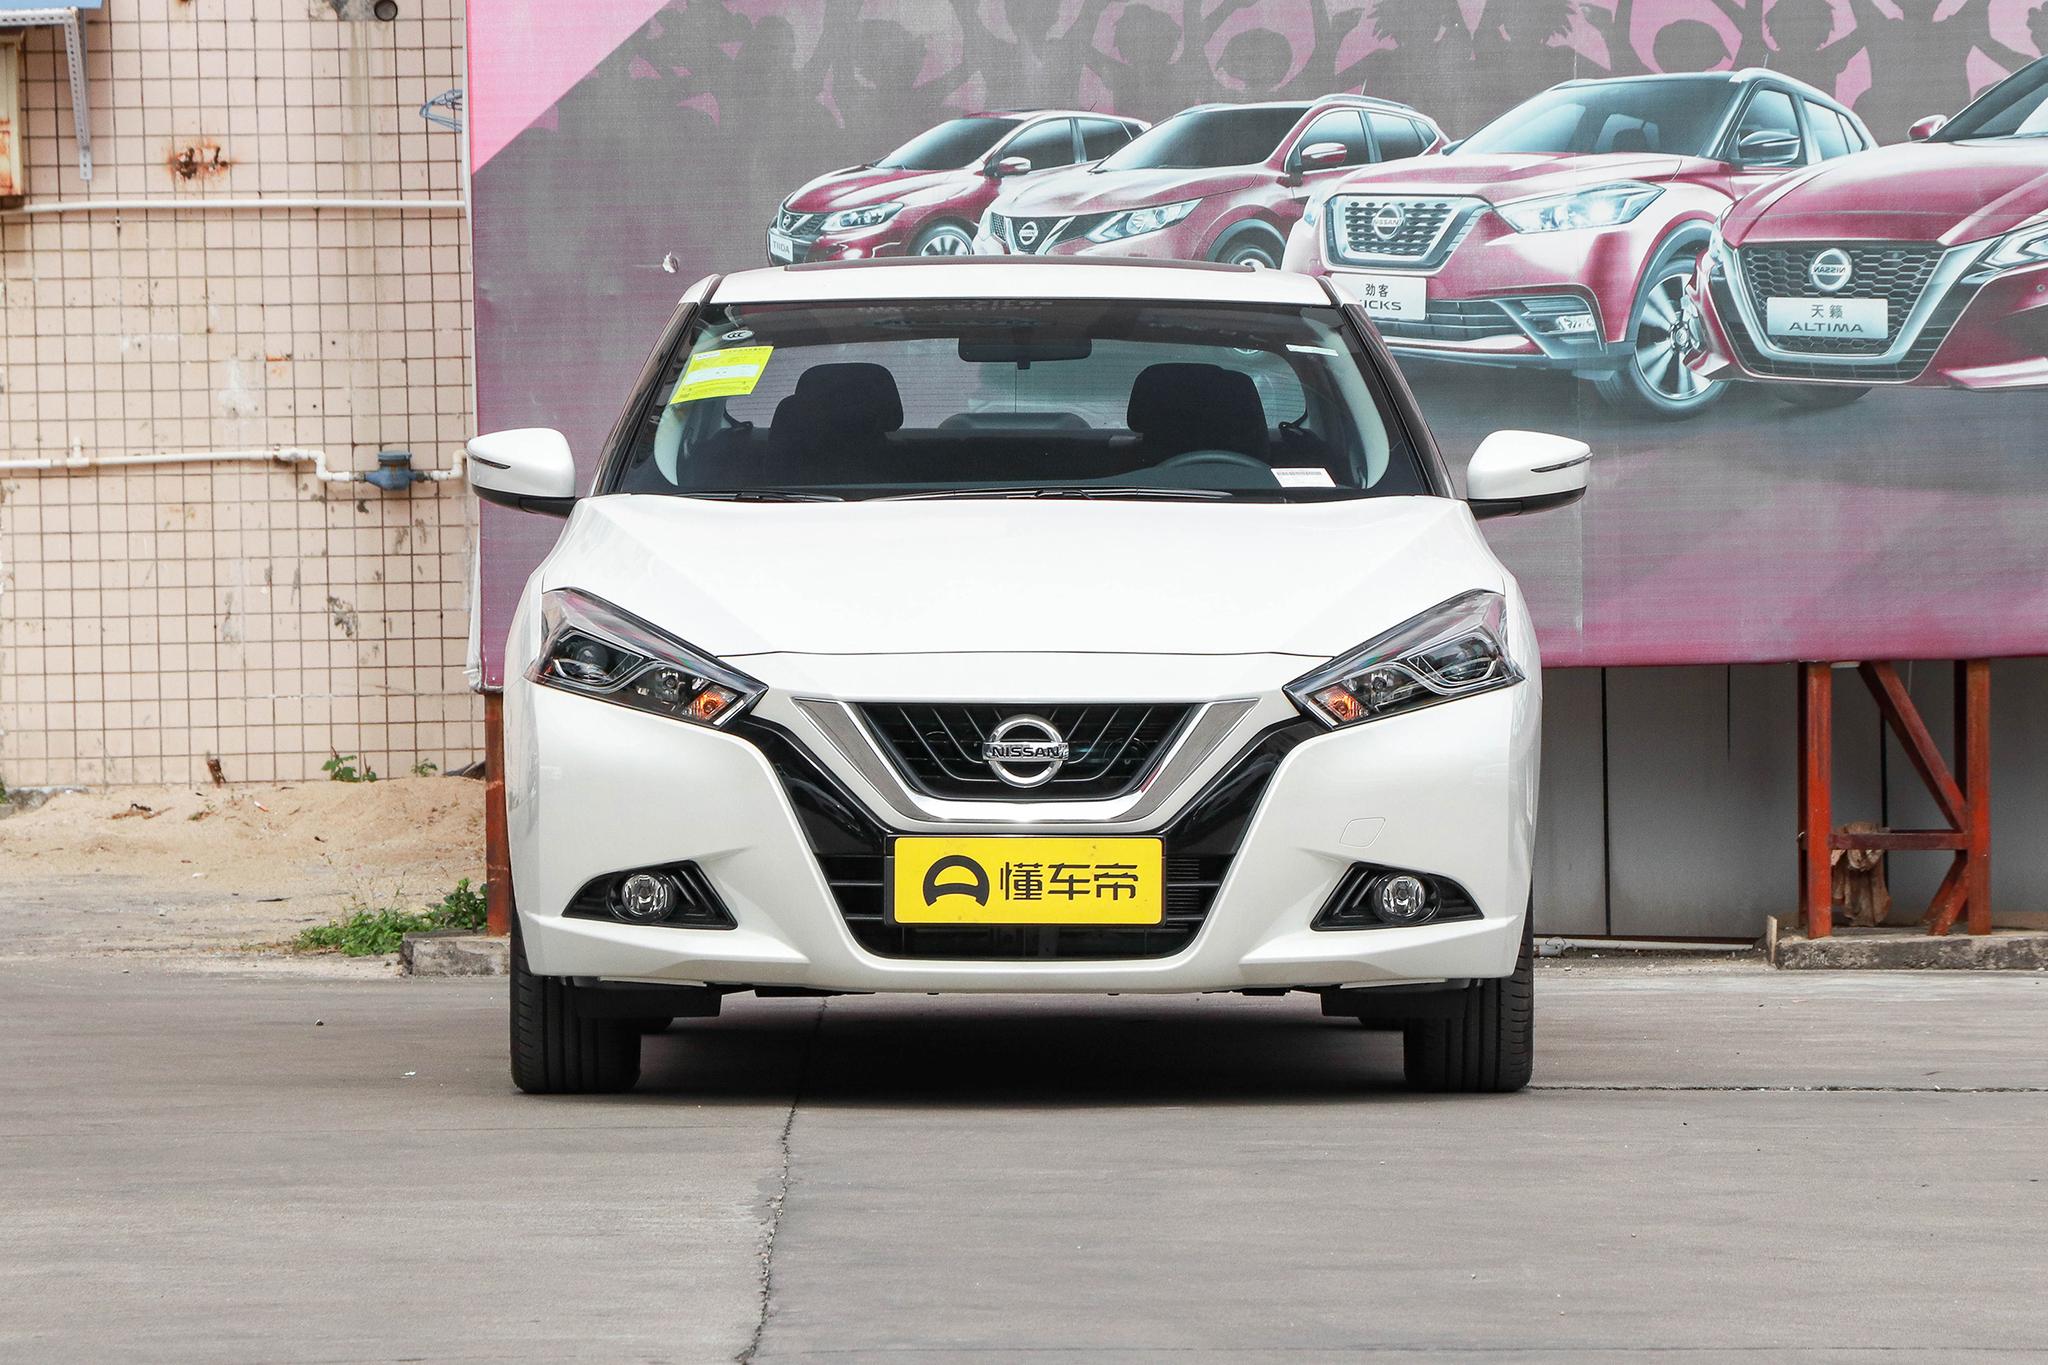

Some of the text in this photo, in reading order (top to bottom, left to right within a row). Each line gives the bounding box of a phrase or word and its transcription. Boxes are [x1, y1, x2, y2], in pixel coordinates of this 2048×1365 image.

[1366, 284, 1389, 298] 劲客
[1360, 300, 1402, 311] ICKS
[1811, 304, 1843, 319] 天籁
[1789, 322, 1864, 333] ALTIMA
[992, 747, 1060, 757] NISSAN
[1000, 862, 1139, 900] 懂车帝
